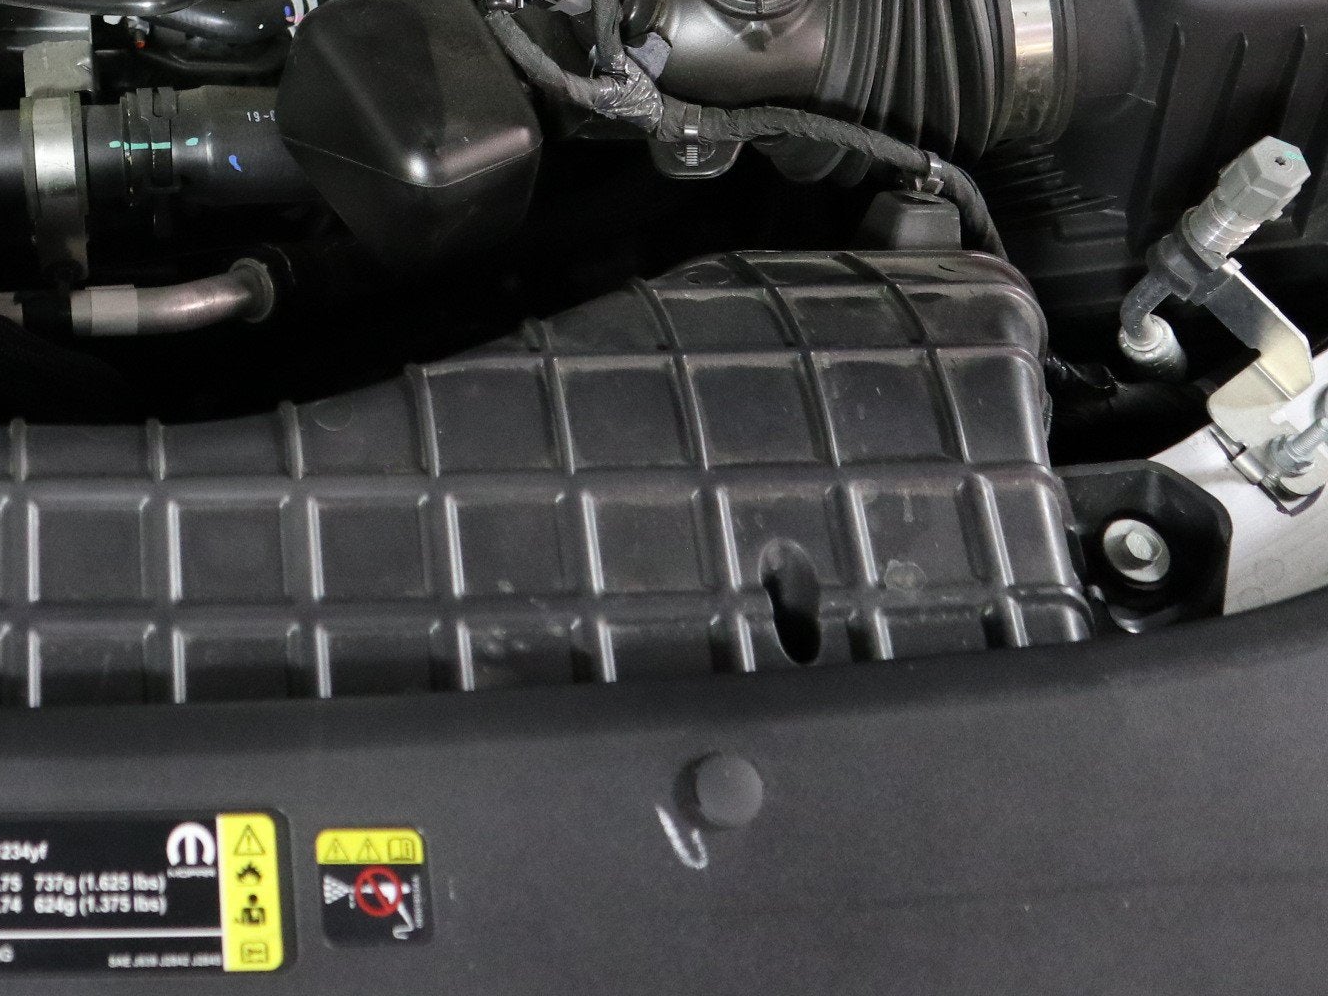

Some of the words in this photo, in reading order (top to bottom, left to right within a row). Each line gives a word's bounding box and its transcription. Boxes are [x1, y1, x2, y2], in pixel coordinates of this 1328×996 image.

[33, 872, 76, 895] 737g
[78, 872, 131, 896] (1.625
[133, 871, 166, 895] lbs)
[33, 894, 76, 917] 624g
[78, 893, 131, 917] (1.375
[133, 893, 167, 916] lbs)
